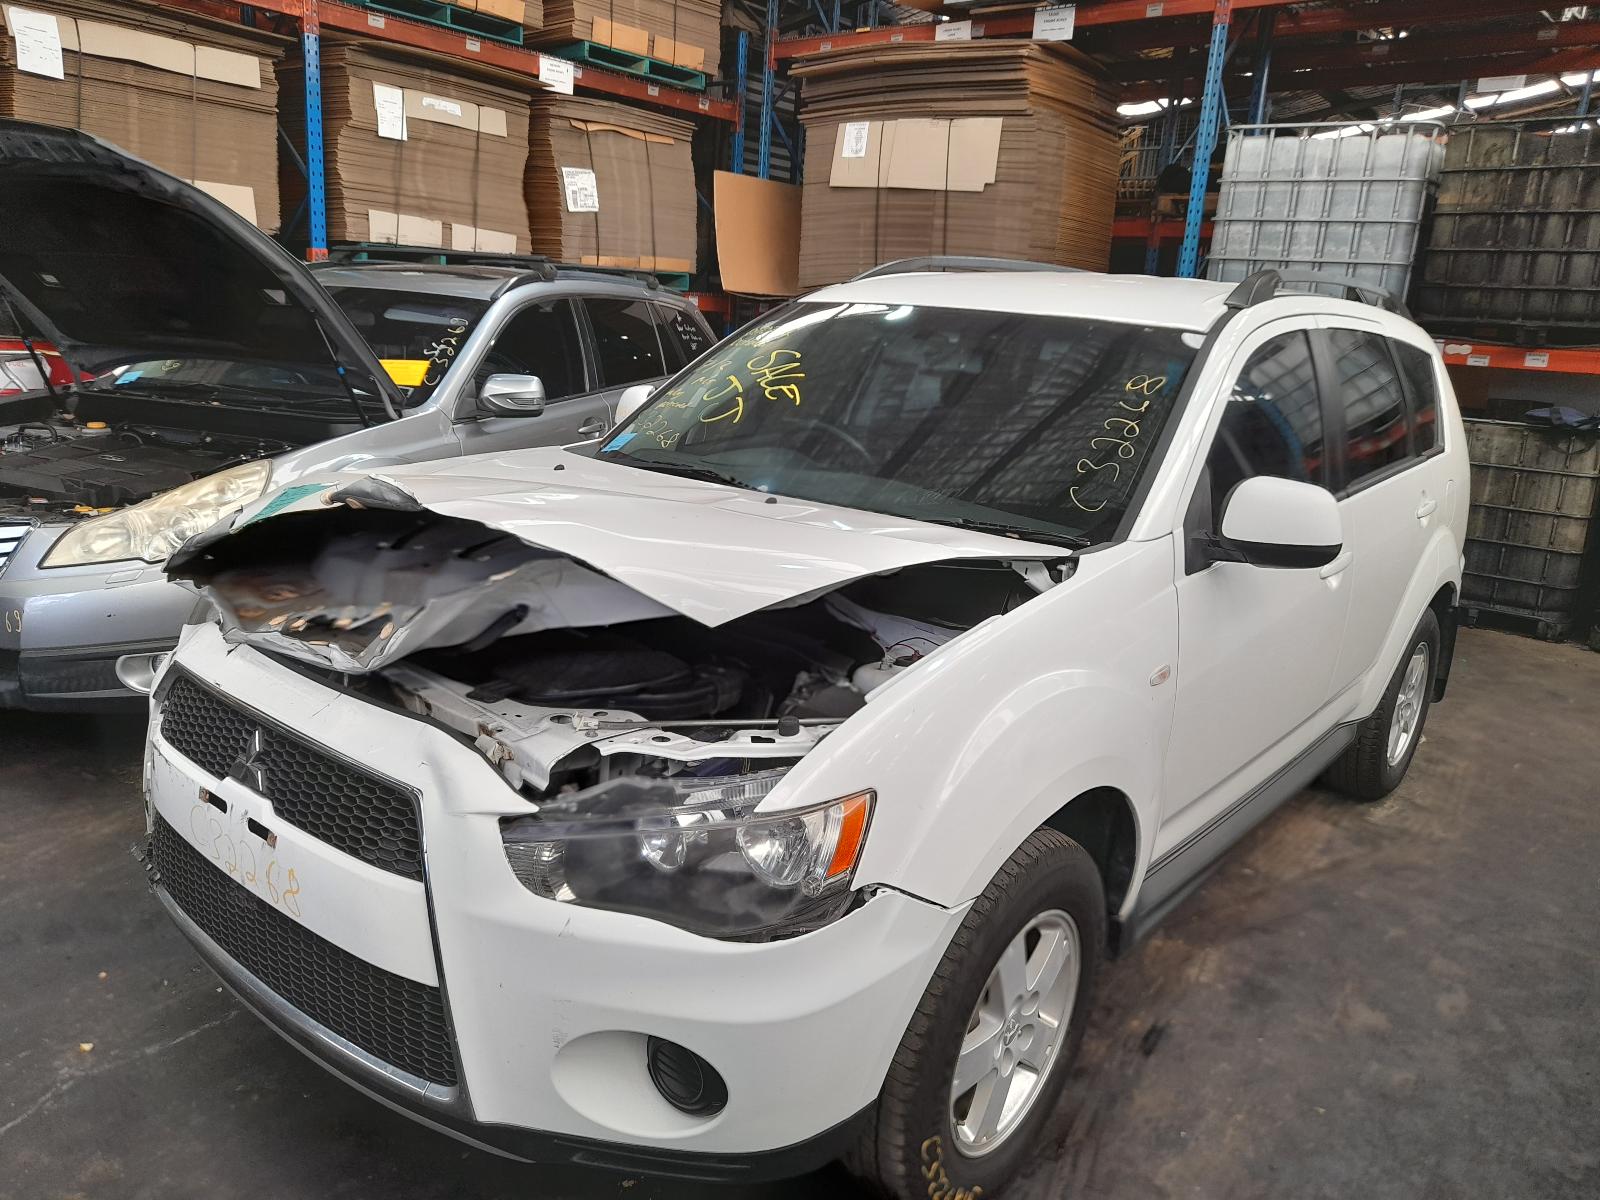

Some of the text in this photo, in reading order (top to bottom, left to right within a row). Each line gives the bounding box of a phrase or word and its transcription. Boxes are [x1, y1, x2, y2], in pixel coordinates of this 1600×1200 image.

[747, 350, 805, 406] SALE
[1070, 374, 1168, 511] C32268
[190, 805, 302, 918] C32268
